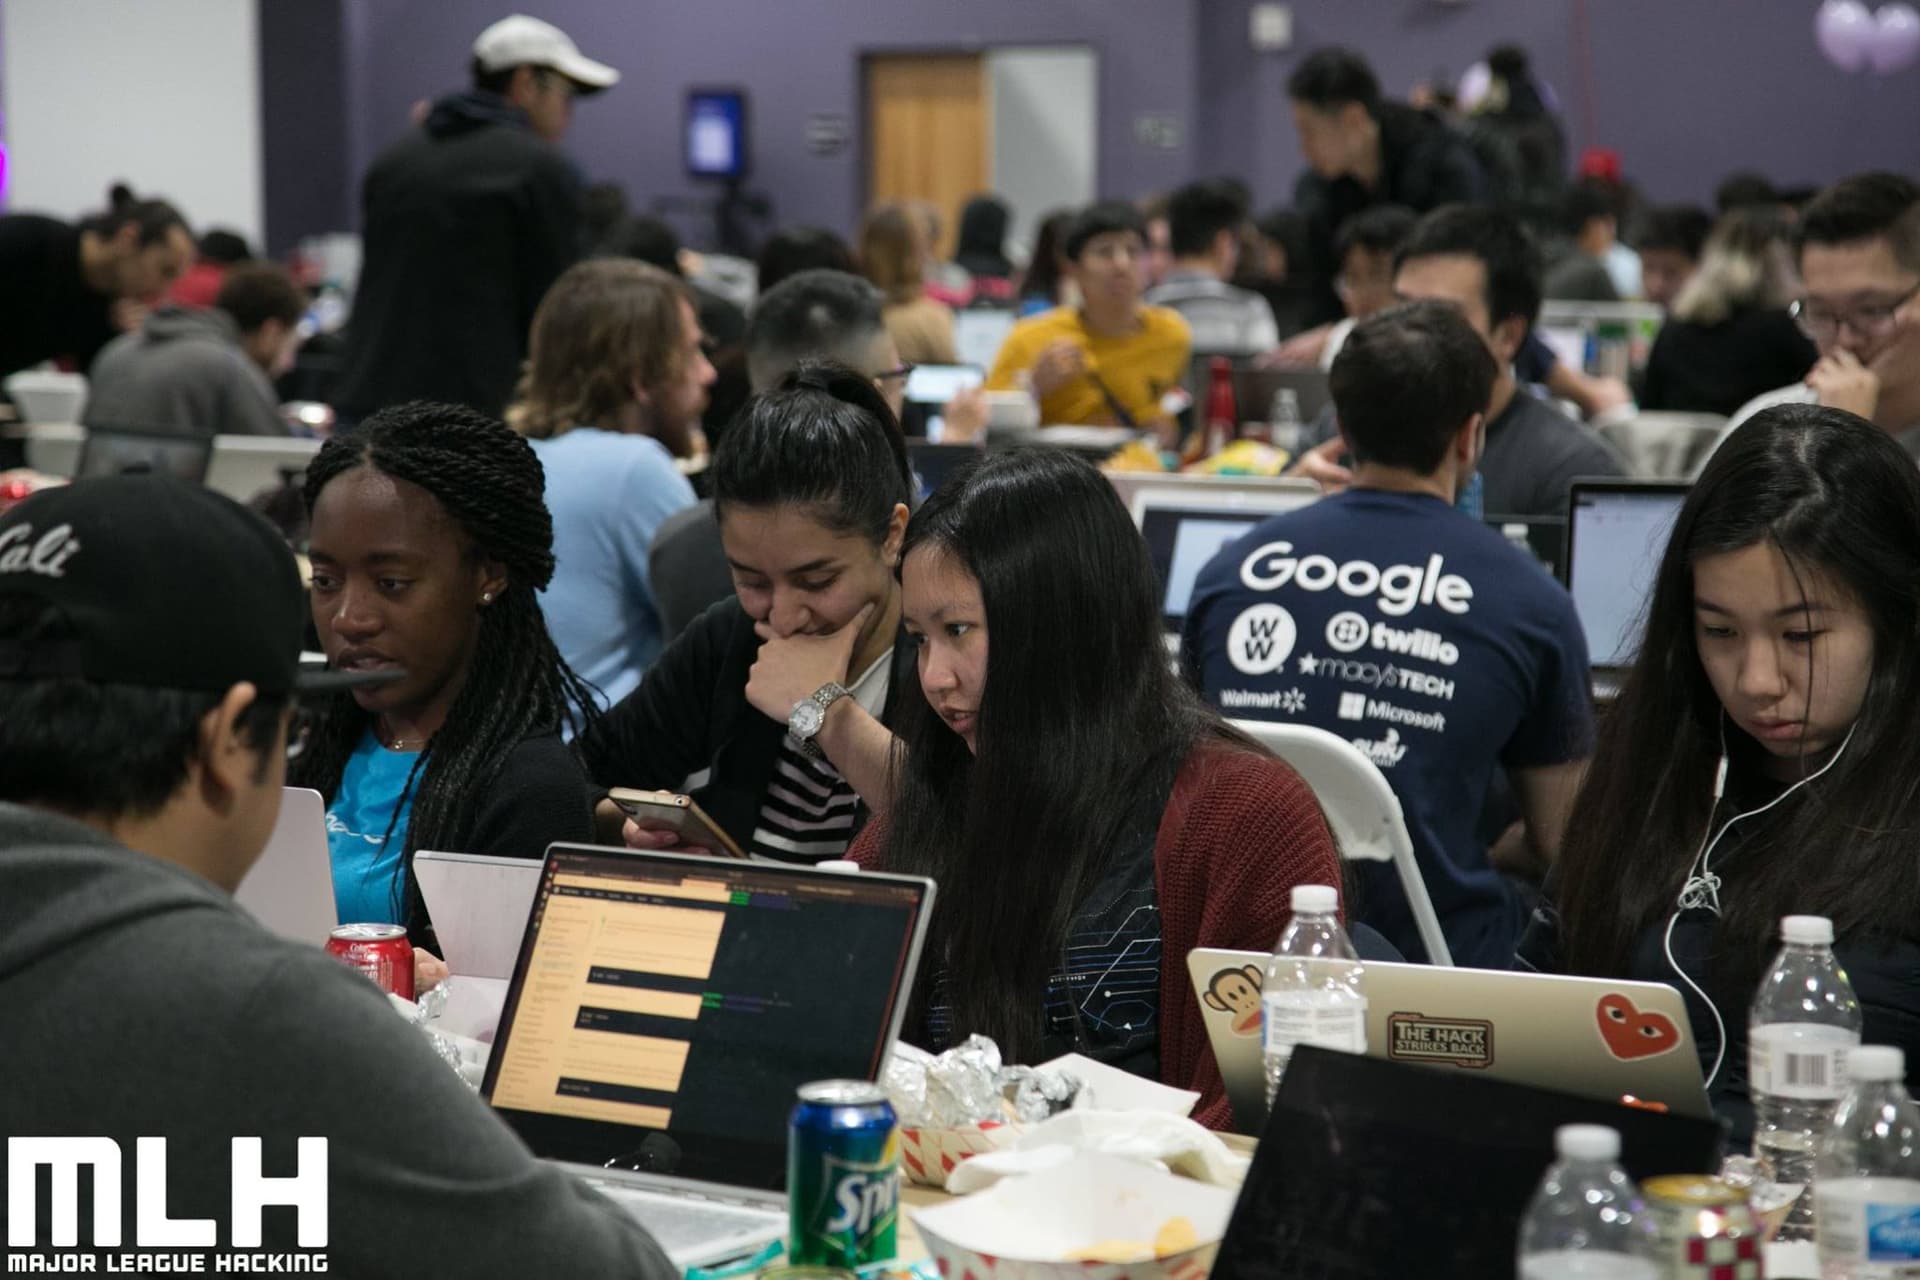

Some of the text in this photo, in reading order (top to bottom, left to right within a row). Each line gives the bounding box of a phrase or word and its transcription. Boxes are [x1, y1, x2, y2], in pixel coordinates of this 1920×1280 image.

[1240, 541, 1474, 616] Google
[1221, 689, 1281, 709] Walmart
[1366, 699, 1446, 732] Microsoft
[1395, 1022, 1485, 1044] THE HACK
[1397, 1039, 1485, 1055] STRIKES BACK
[828, 1172, 900, 1234] Spr
